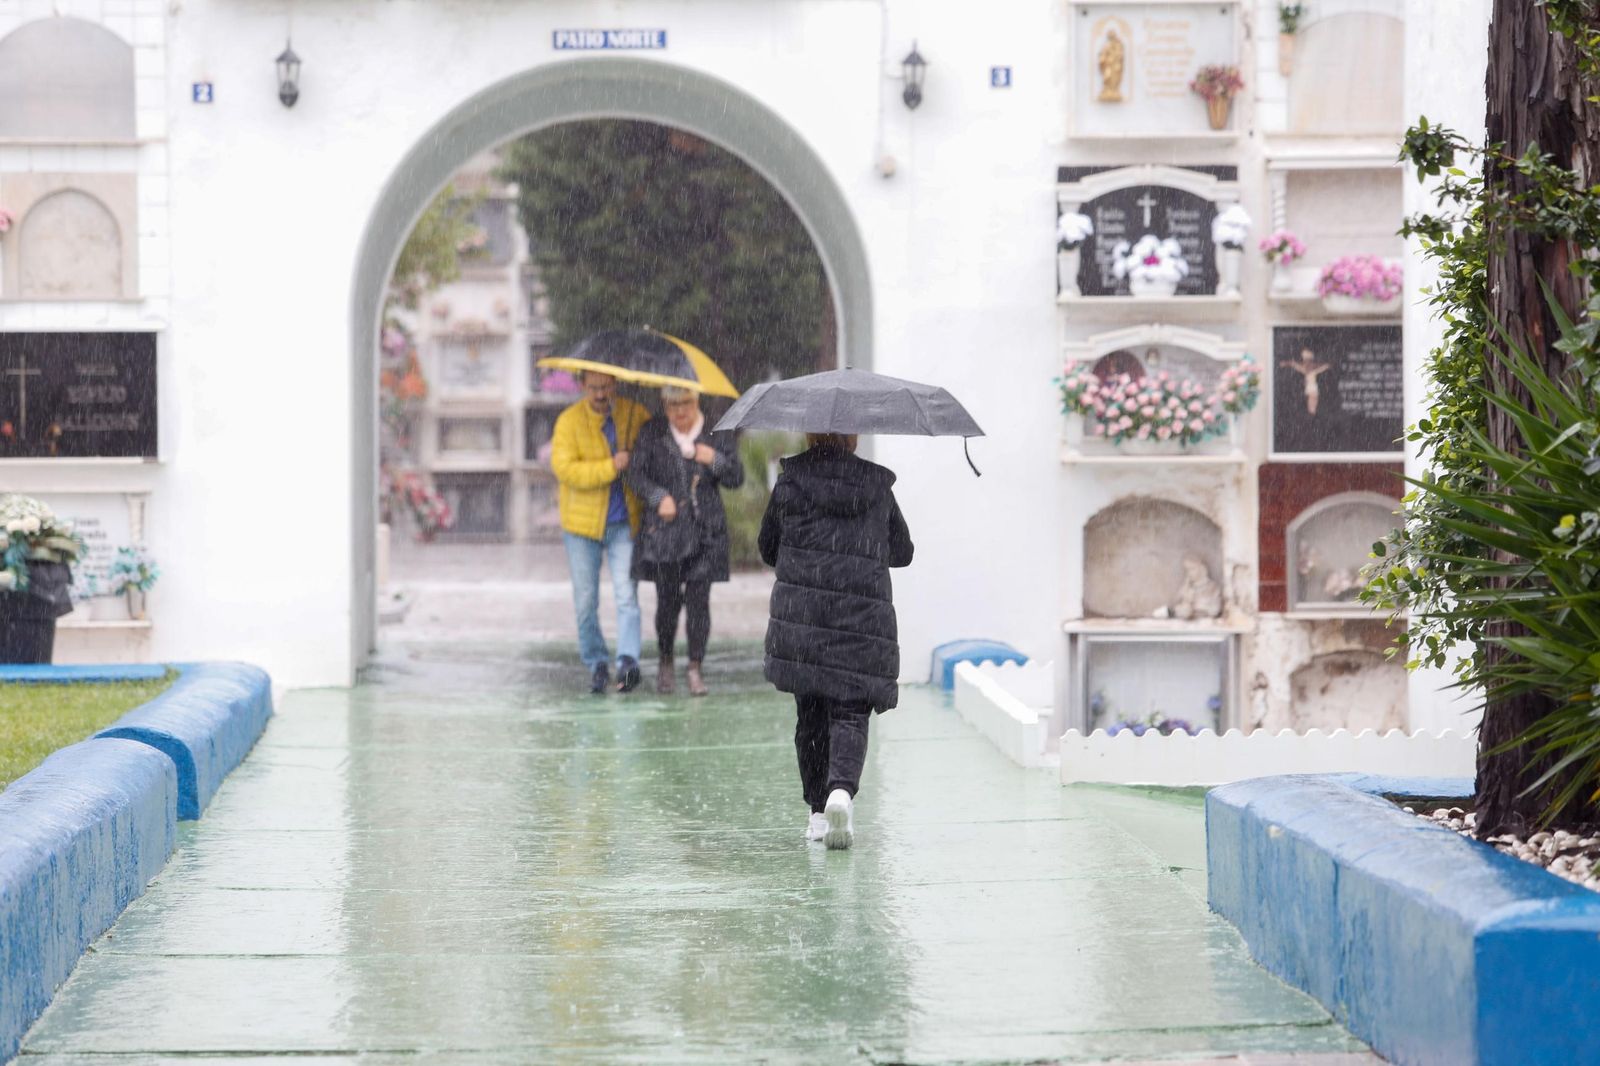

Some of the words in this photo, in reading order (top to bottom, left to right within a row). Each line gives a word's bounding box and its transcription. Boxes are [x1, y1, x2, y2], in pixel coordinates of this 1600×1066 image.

[556, 31, 604, 48] PATIO
[608, 31, 660, 48] NORTE
[994, 68, 1007, 86] 3
[196, 84, 210, 102] 2
